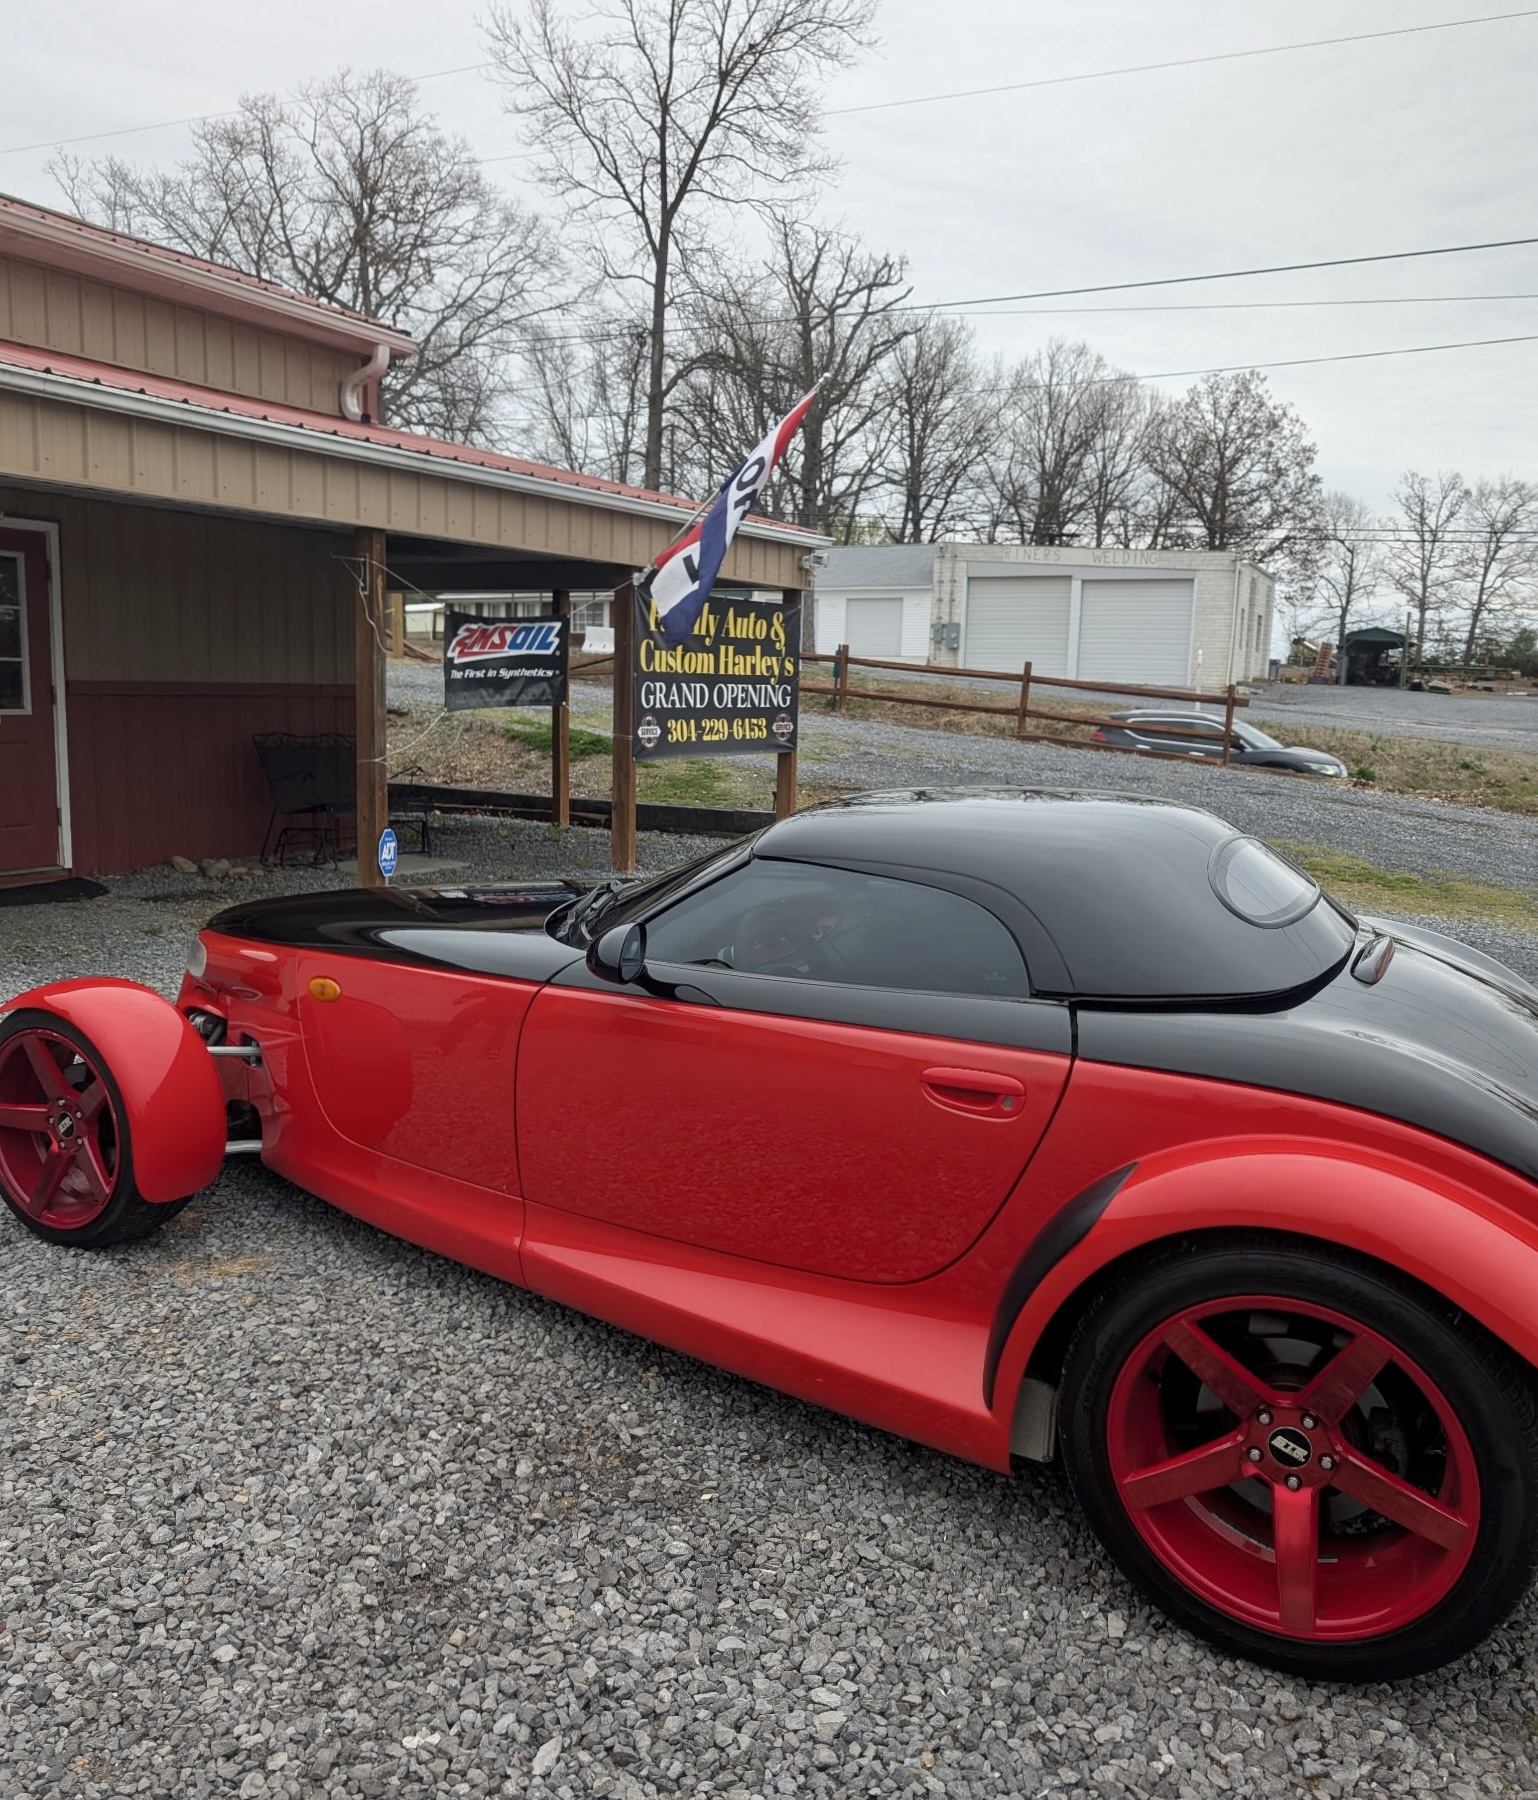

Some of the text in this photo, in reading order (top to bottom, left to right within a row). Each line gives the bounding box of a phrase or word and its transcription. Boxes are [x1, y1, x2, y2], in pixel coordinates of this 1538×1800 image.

[1093, 551, 1158, 565] WELDING
[720, 606, 769, 639] Auto
[770, 611, 786, 649] &
[448, 623, 560, 663] AMSOIL
[450, 667, 554, 680] The First in Synthetics
[639, 638, 795, 685] Custom Harley's
[641, 681, 792, 709] GRAND OPENING
[641, 727, 658, 736] SERVICE
[667, 717, 768, 743] 304-229-6453
[381, 842, 396, 861] ADT
